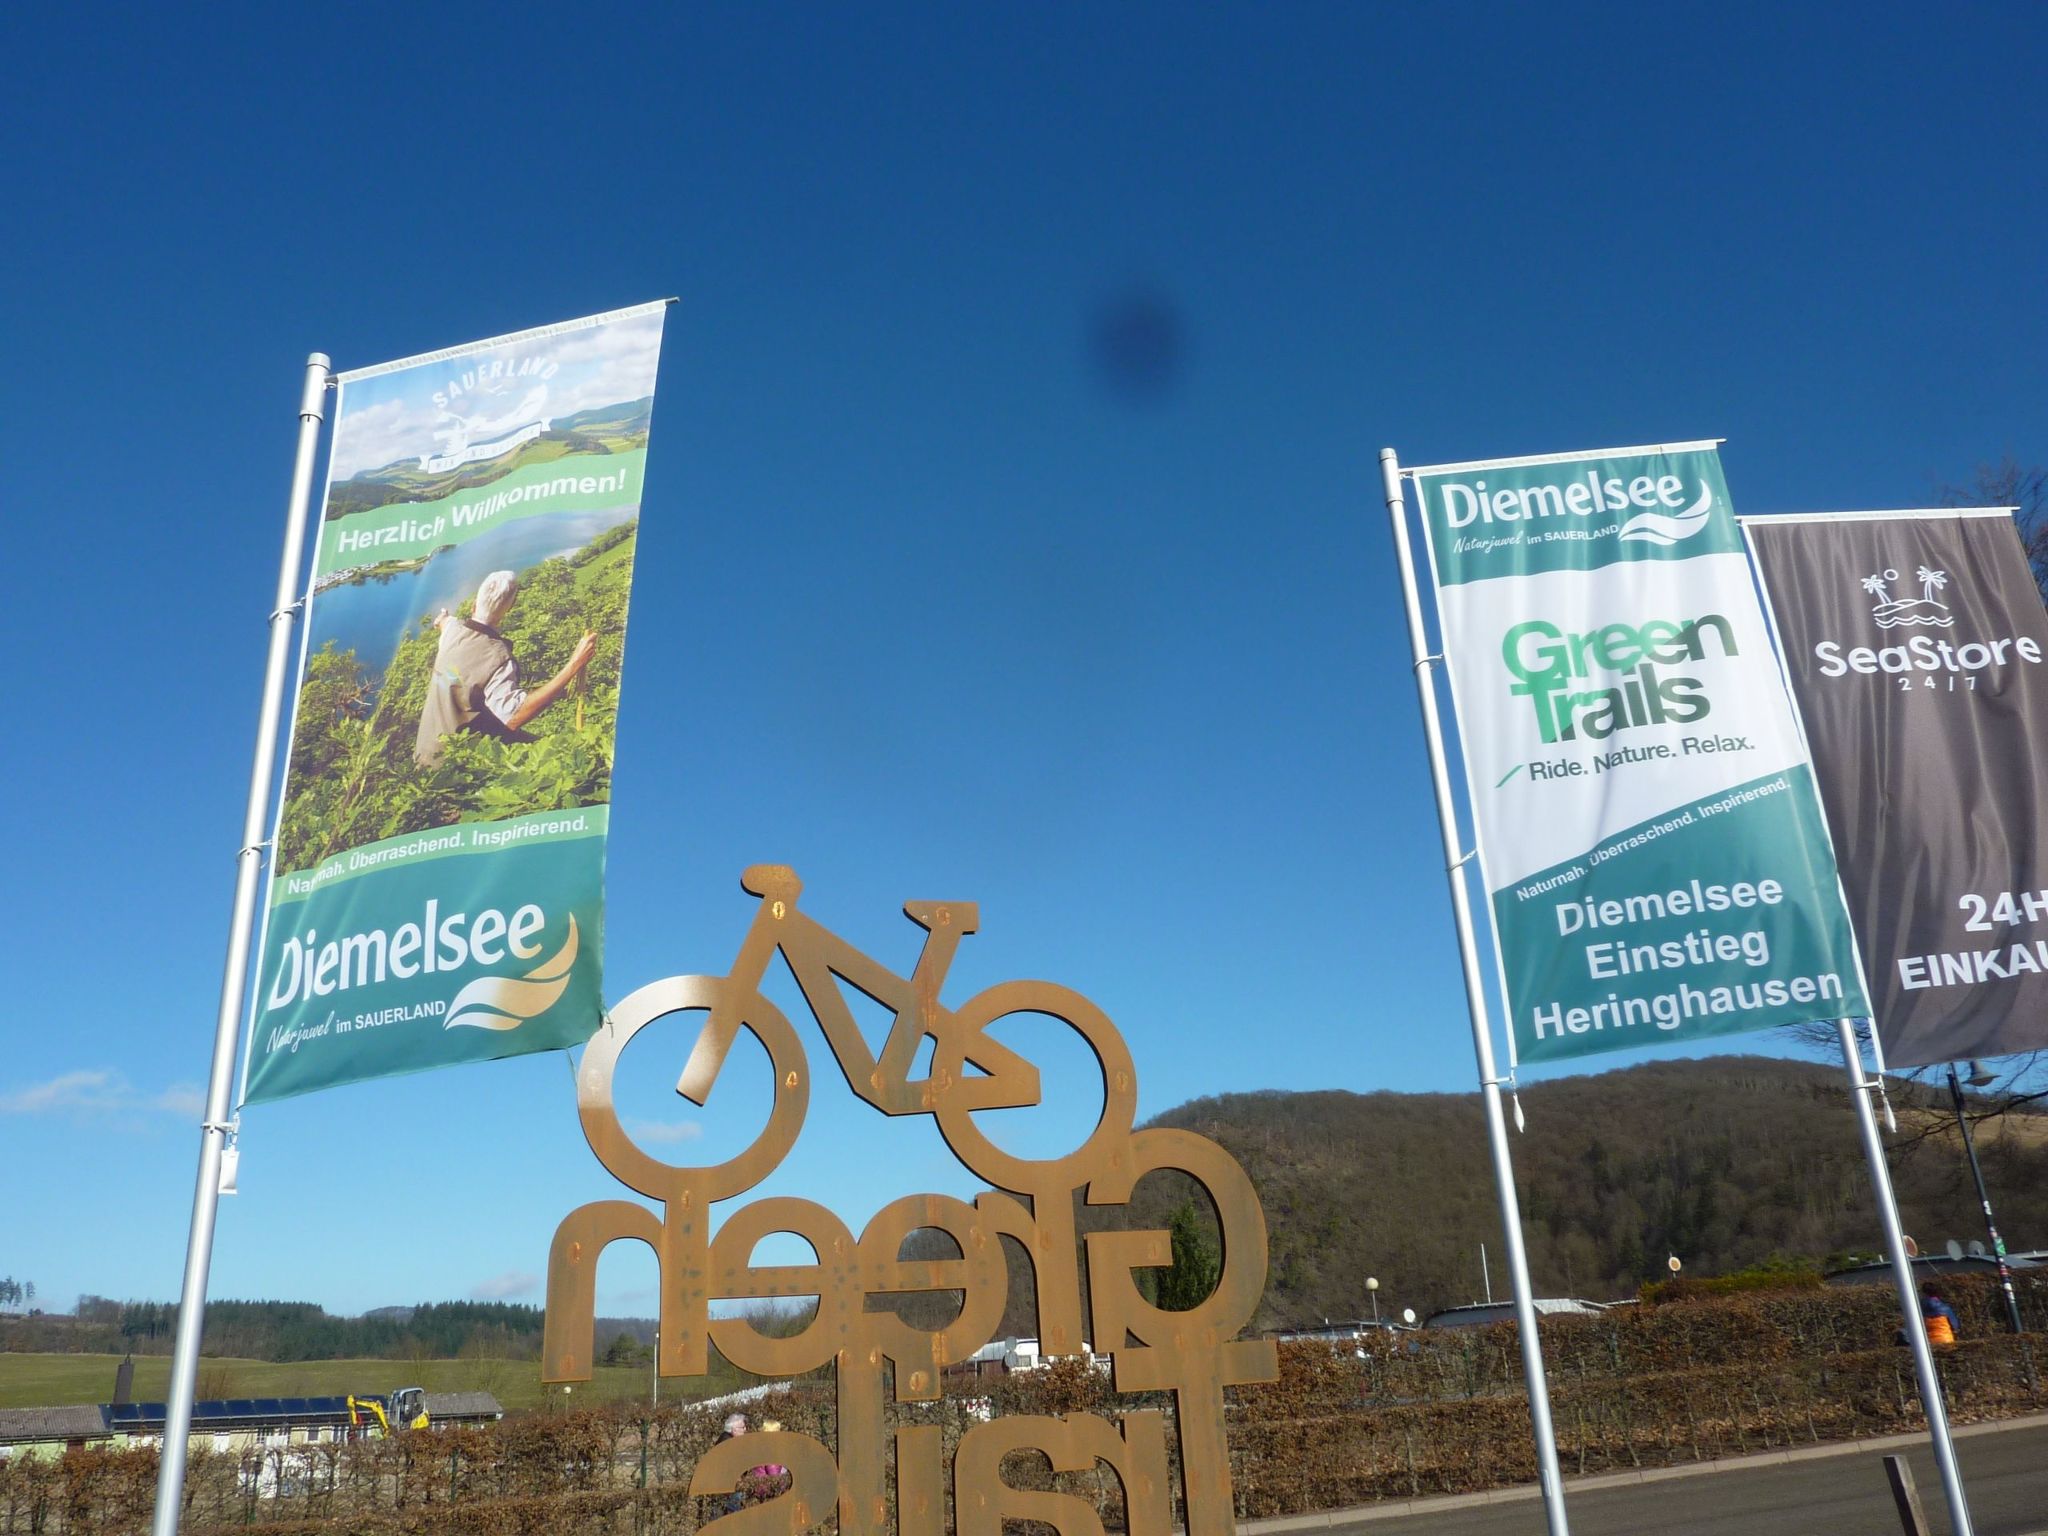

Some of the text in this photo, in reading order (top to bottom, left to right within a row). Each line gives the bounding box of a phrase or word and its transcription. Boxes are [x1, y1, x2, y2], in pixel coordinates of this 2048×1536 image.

[432, 357, 559, 409] SAUERLAND
[338, 468, 627, 553] Herzlich Willkommen!
[1441, 470, 1685, 528] Diemelsee
[1453, 524, 1619, 554] Naturjuwel im SAUERLAND
[1501, 614, 1740, 682] Green
[1815, 635, 2042, 677] SeaStore
[1510, 663, 1711, 744] Trails
[1529, 735, 1755, 782] Ride. Nature. Relax.
[349, 831, 465, 871] Überraschend.
[472, 815, 589, 846] Inspirierend.
[1517, 778, 1791, 901] Naturnah. Überraschend. Inspirierend.
[1556, 879, 1784, 937] Diemelsee
[267, 898, 546, 1012] Diemelsee
[1586, 929, 1769, 979] Einstieg
[336, 1020, 351, 1033] im
[355, 1000, 446, 1029] SAUERLAND
[1533, 973, 1844, 1040] Heringhausen
